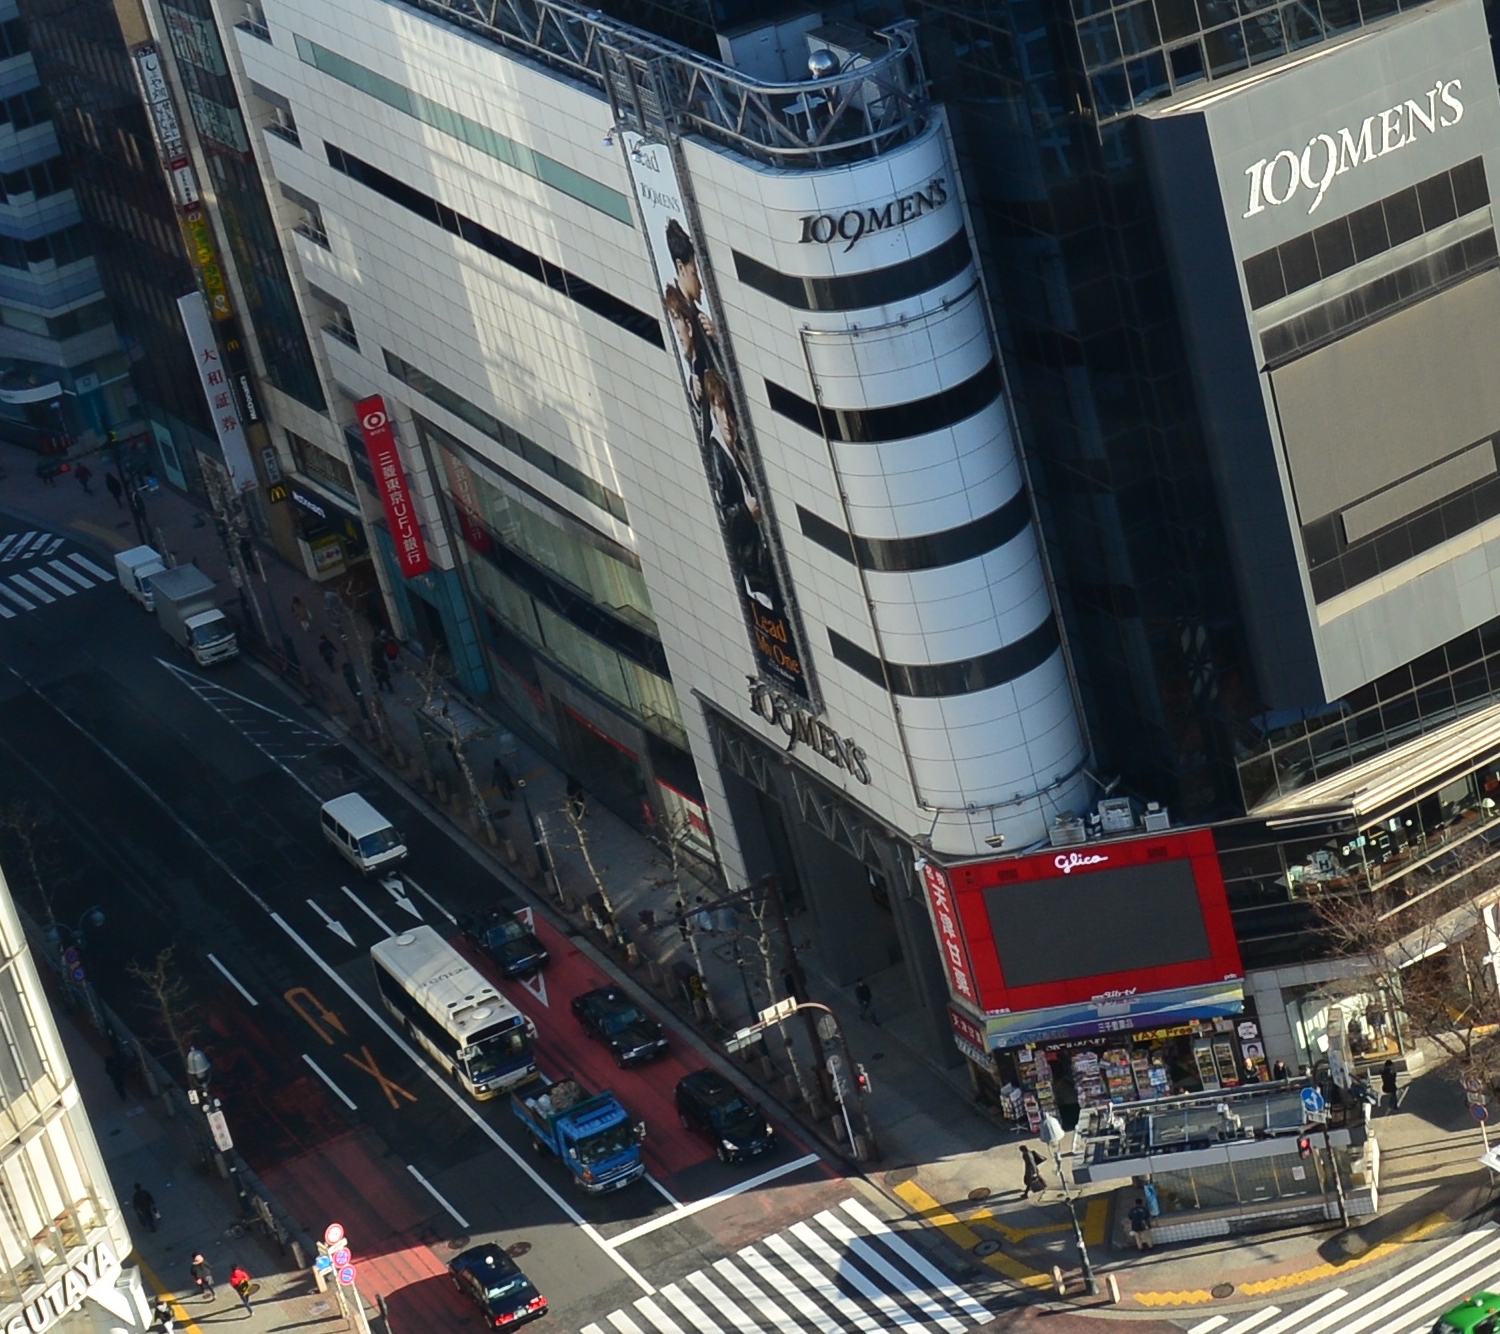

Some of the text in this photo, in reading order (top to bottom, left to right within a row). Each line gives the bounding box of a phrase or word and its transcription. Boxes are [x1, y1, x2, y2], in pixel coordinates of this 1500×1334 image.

[200, 348, 238, 434] 大和証券
[751, 601, 788, 644] Lead
[773, 644, 800, 674] One
[1054, 852, 1109, 874] Glico
[1133, 1026, 1193, 1042] TAX Free
